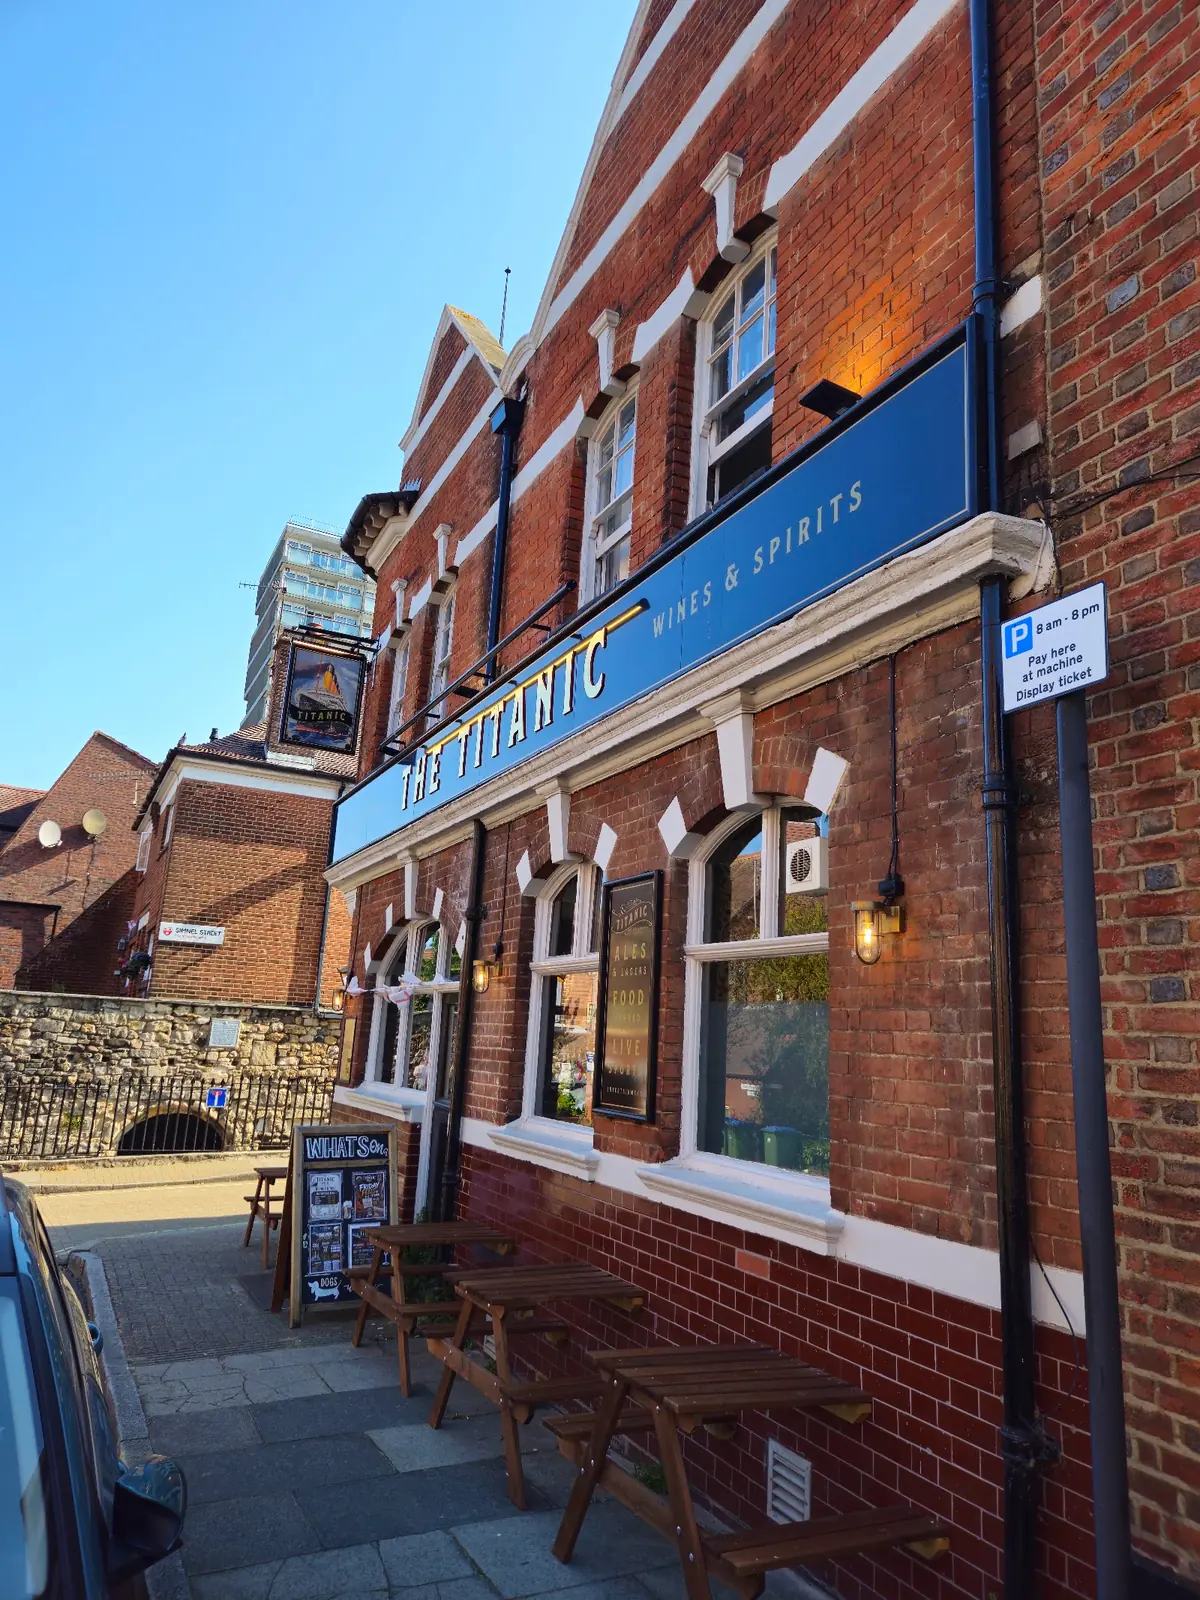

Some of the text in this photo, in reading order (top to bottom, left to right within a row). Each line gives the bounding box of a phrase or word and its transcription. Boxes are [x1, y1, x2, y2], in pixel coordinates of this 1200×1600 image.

[652, 480, 862, 638] WINES & SPIRITS
[1028, 642, 1076, 667] Pay here
[1022, 653, 1083, 683] at machine
[1016, 667, 1092, 701] Display ticket
[298, 711, 346, 721] TITANIC
[402, 627, 608, 810] THE TITANIC
[616, 905, 647, 930] TITANIC
[615, 942, 646, 962] ALES
[613, 989, 644, 1007] FOOD
[613, 1038, 640, 1056] LIVE
[306, 1136, 370, 1159] WHATS
[320, 1277, 338, 1287] DOGS
